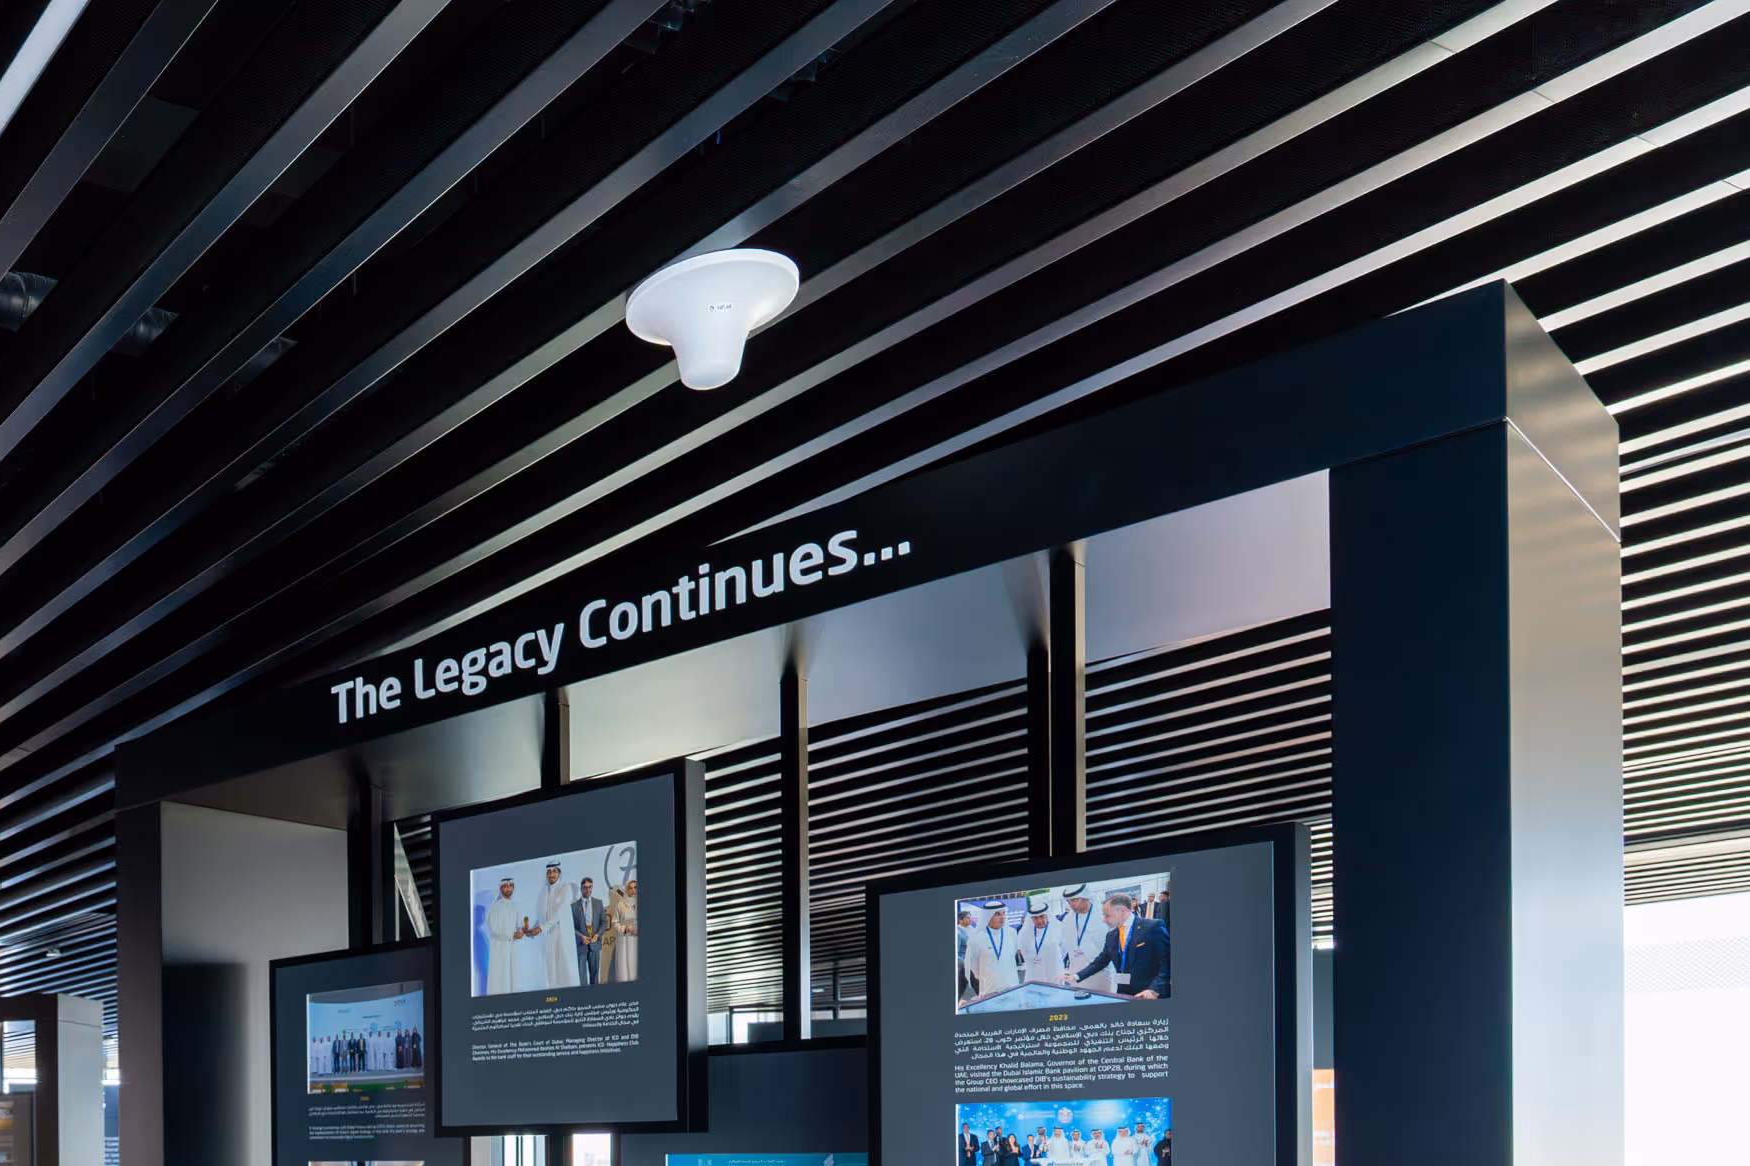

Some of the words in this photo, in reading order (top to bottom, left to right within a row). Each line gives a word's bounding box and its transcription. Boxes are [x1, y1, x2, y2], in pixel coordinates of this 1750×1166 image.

[331, 676, 401, 725] The
[414, 621, 564, 699] Legacy
[578, 530, 912, 648] Continues...
[966, 1063, 998, 1072] Excellency
[1063, 1066, 1088, 1074] pavilion
[1124, 1064, 1146, 1072] during
[966, 1078, 984, 1086] Group
[1052, 1074, 1096, 1083] sustainability
[1098, 1073, 1126, 1081] strategy
[1142, 1071, 1168, 1079] support
[1004, 1084, 1023, 1092] global
